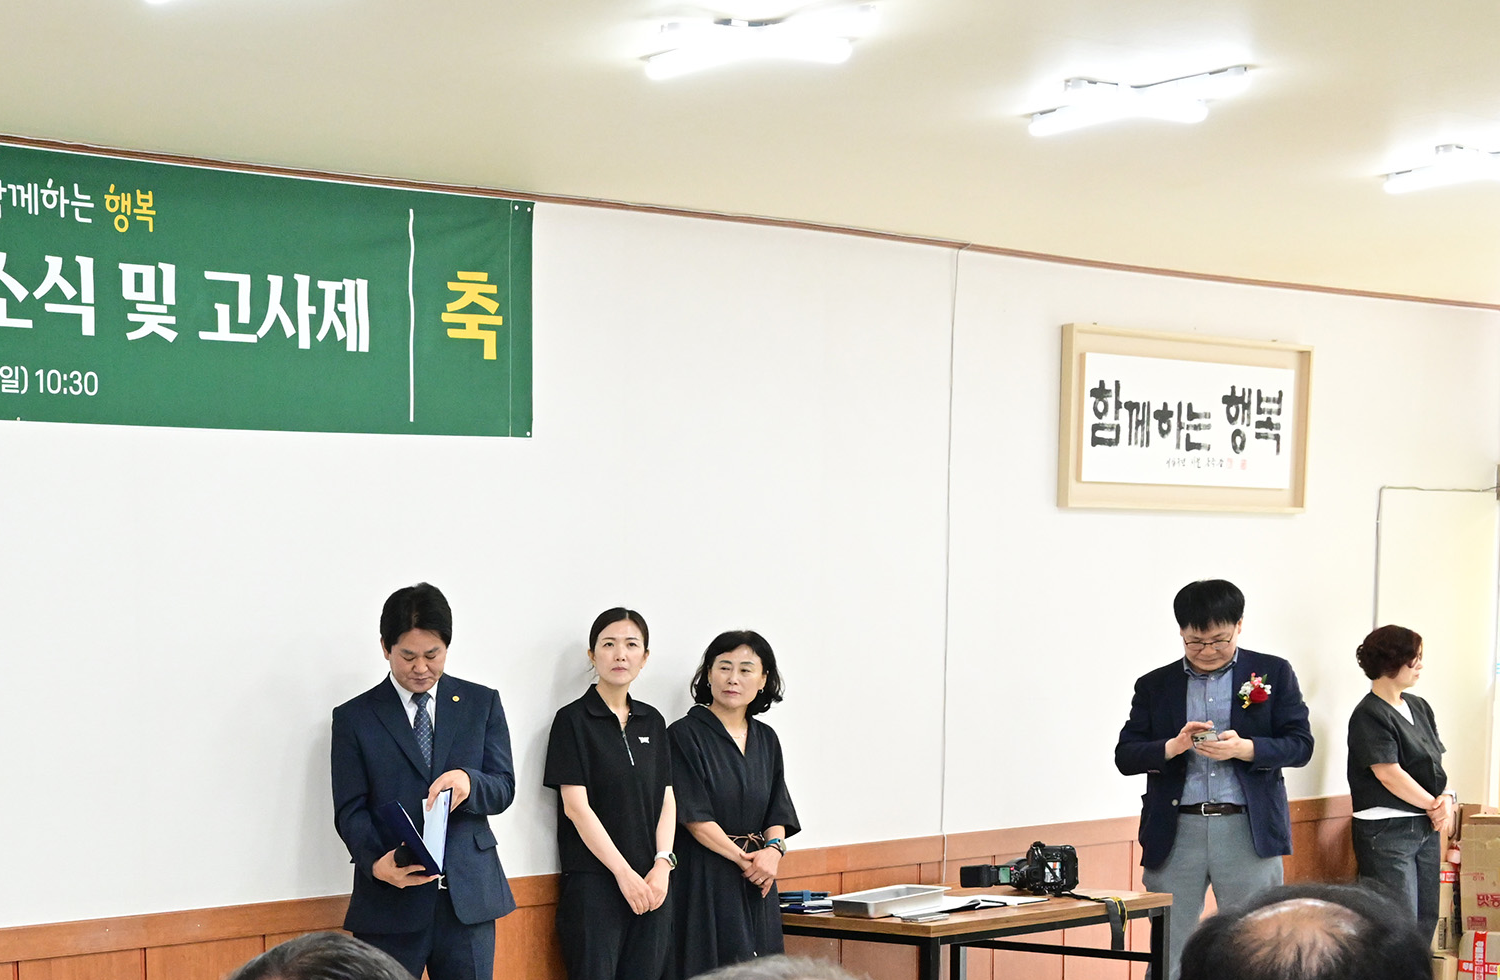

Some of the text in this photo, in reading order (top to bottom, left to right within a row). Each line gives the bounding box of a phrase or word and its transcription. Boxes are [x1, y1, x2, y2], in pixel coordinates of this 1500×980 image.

[104, 184, 156, 232] 행복
[119, 262, 178, 342] 및
[199, 271, 369, 352] 고사제
[441, 271, 503, 360] 축
[36, 369, 98, 395] 10:30
[1089, 379, 1284, 456] 함께하는 행복
